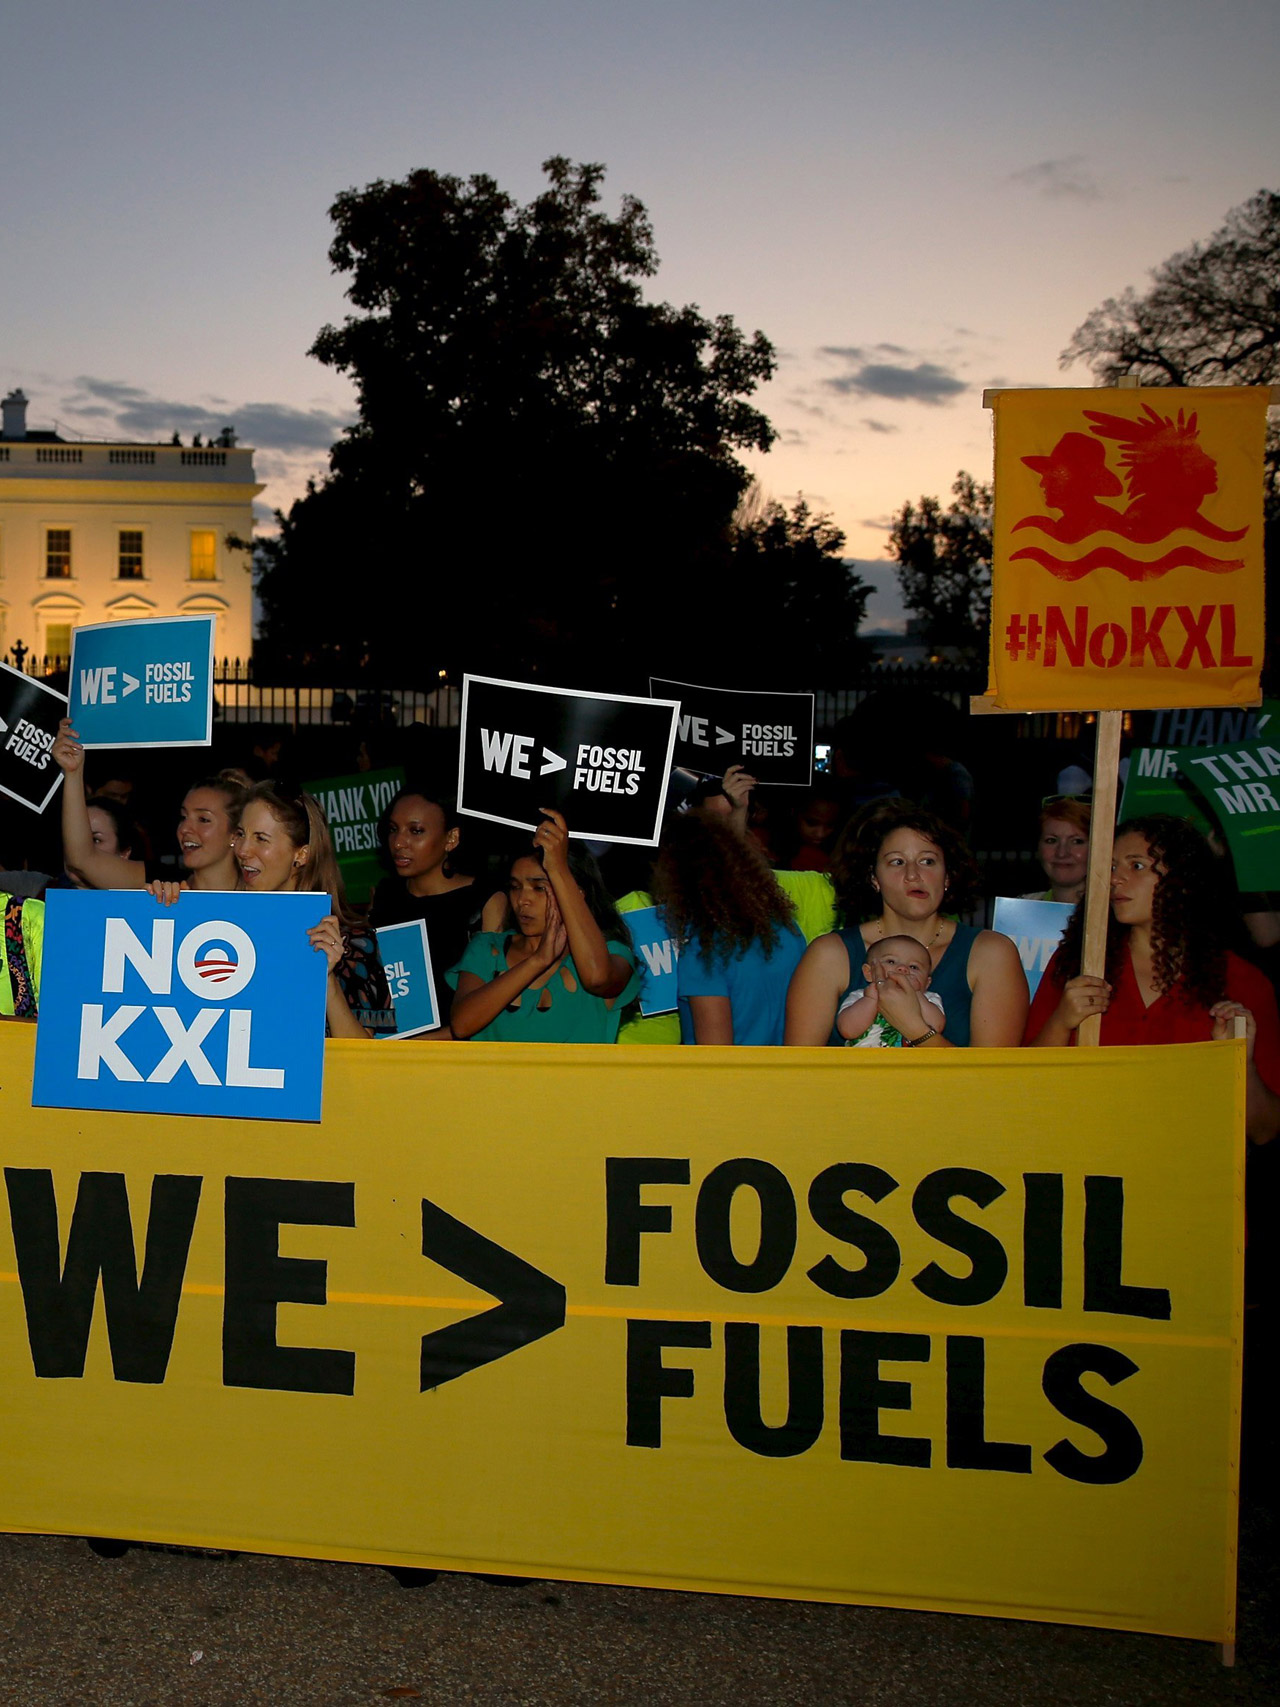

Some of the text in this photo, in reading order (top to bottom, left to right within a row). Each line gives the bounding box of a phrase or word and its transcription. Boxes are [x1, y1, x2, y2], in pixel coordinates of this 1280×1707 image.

[1005, 604, 1253, 669] #NoKXL
[80, 667, 117, 705] WE
[145, 662, 195, 682] FOSSIL
[145, 682, 192, 704] FUELS
[14, 718, 56, 753] FOSSI
[742, 723, 797, 741] FOSSIL
[1151, 709, 1272, 748] THANK
[5, 735, 51, 770] FUELS
[480, 727, 535, 780] WE
[576, 744, 646, 772] FOSSIL
[742, 740, 795, 757] FUELS
[573, 768, 641, 795] FUELS
[102, 917, 256, 1000] NO
[640, 938, 686, 976] W
[77, 1003, 285, 1089] KXL
[604, 1157, 1171, 1321] FOSSIL
[4, 1167, 357, 1397] WE
[626, 1318, 1144, 1485] FUELS
